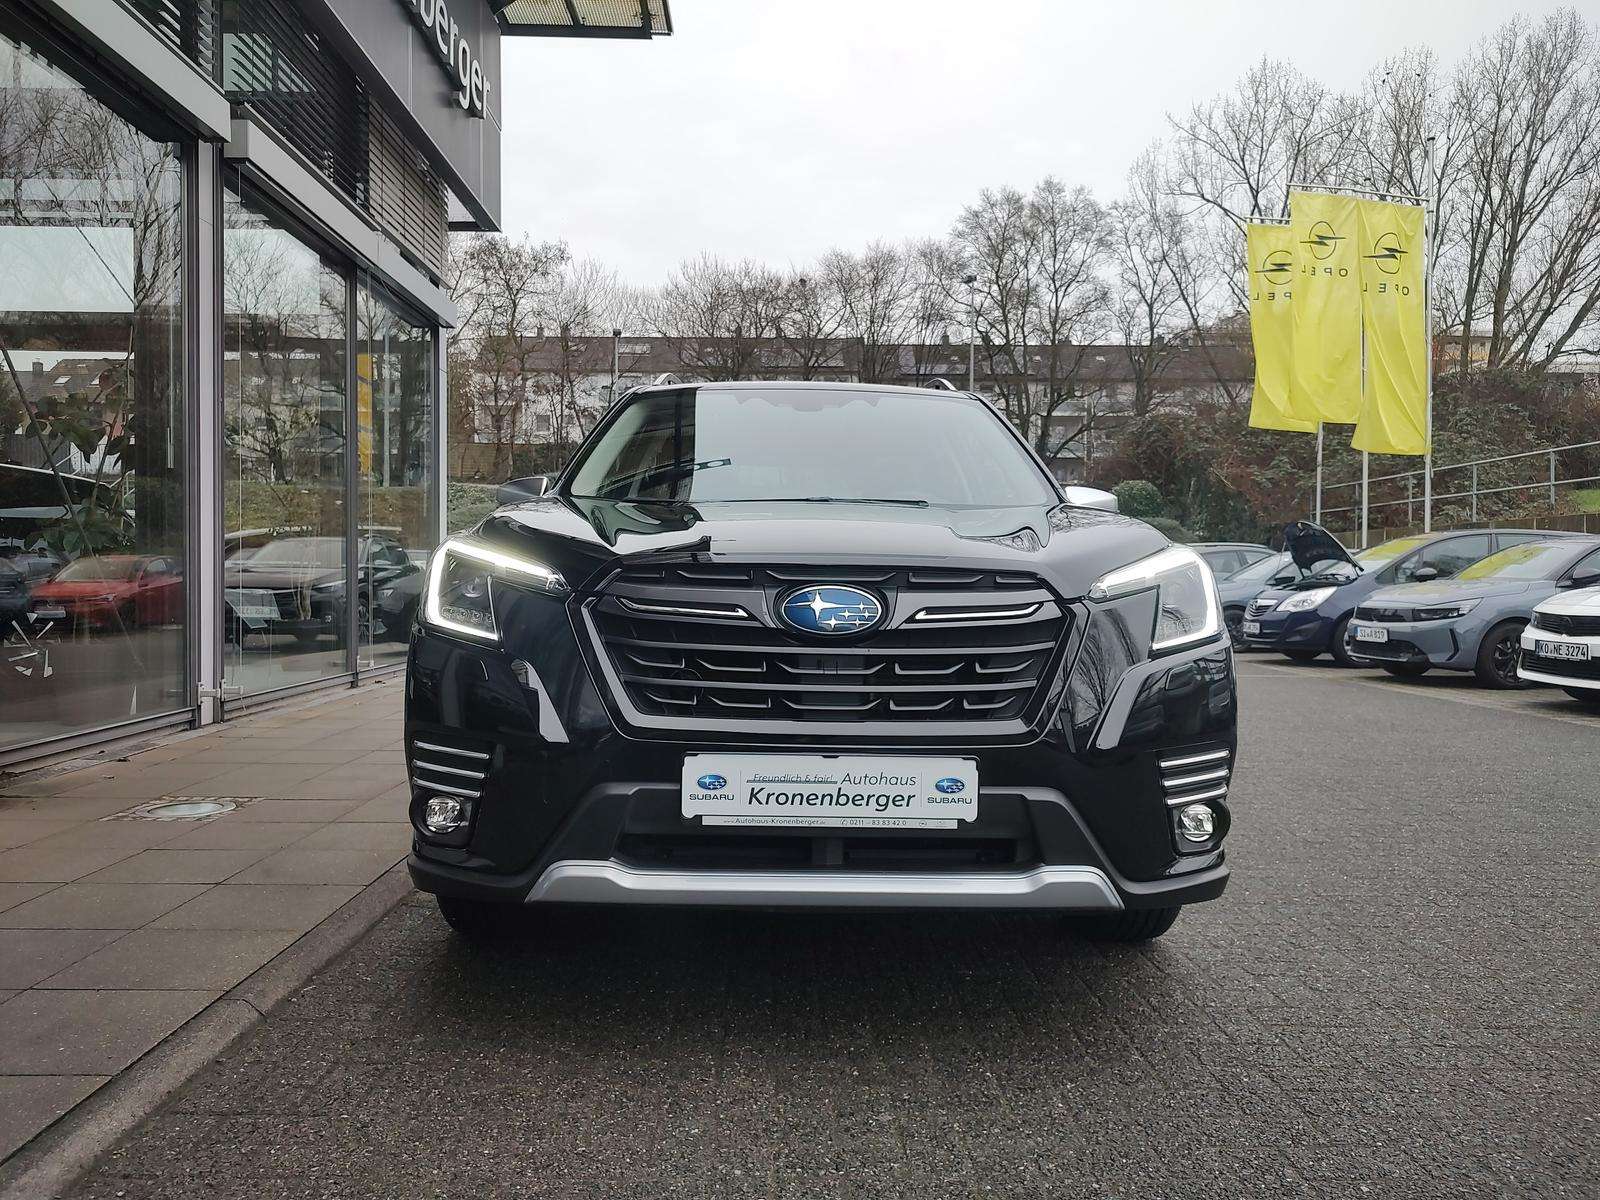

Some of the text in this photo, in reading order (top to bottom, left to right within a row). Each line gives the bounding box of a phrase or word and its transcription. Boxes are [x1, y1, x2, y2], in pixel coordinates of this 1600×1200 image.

[411, 0, 491, 119] erger
[1565, 645, 1586, 658] 3274
[753, 773, 802, 783] Freundlich
[840, 771, 917, 786] Autohaus
[689, 793, 735, 801] SUBARU
[748, 787, 916, 812] Kronenberger
[927, 796, 973, 805] SUBARU
